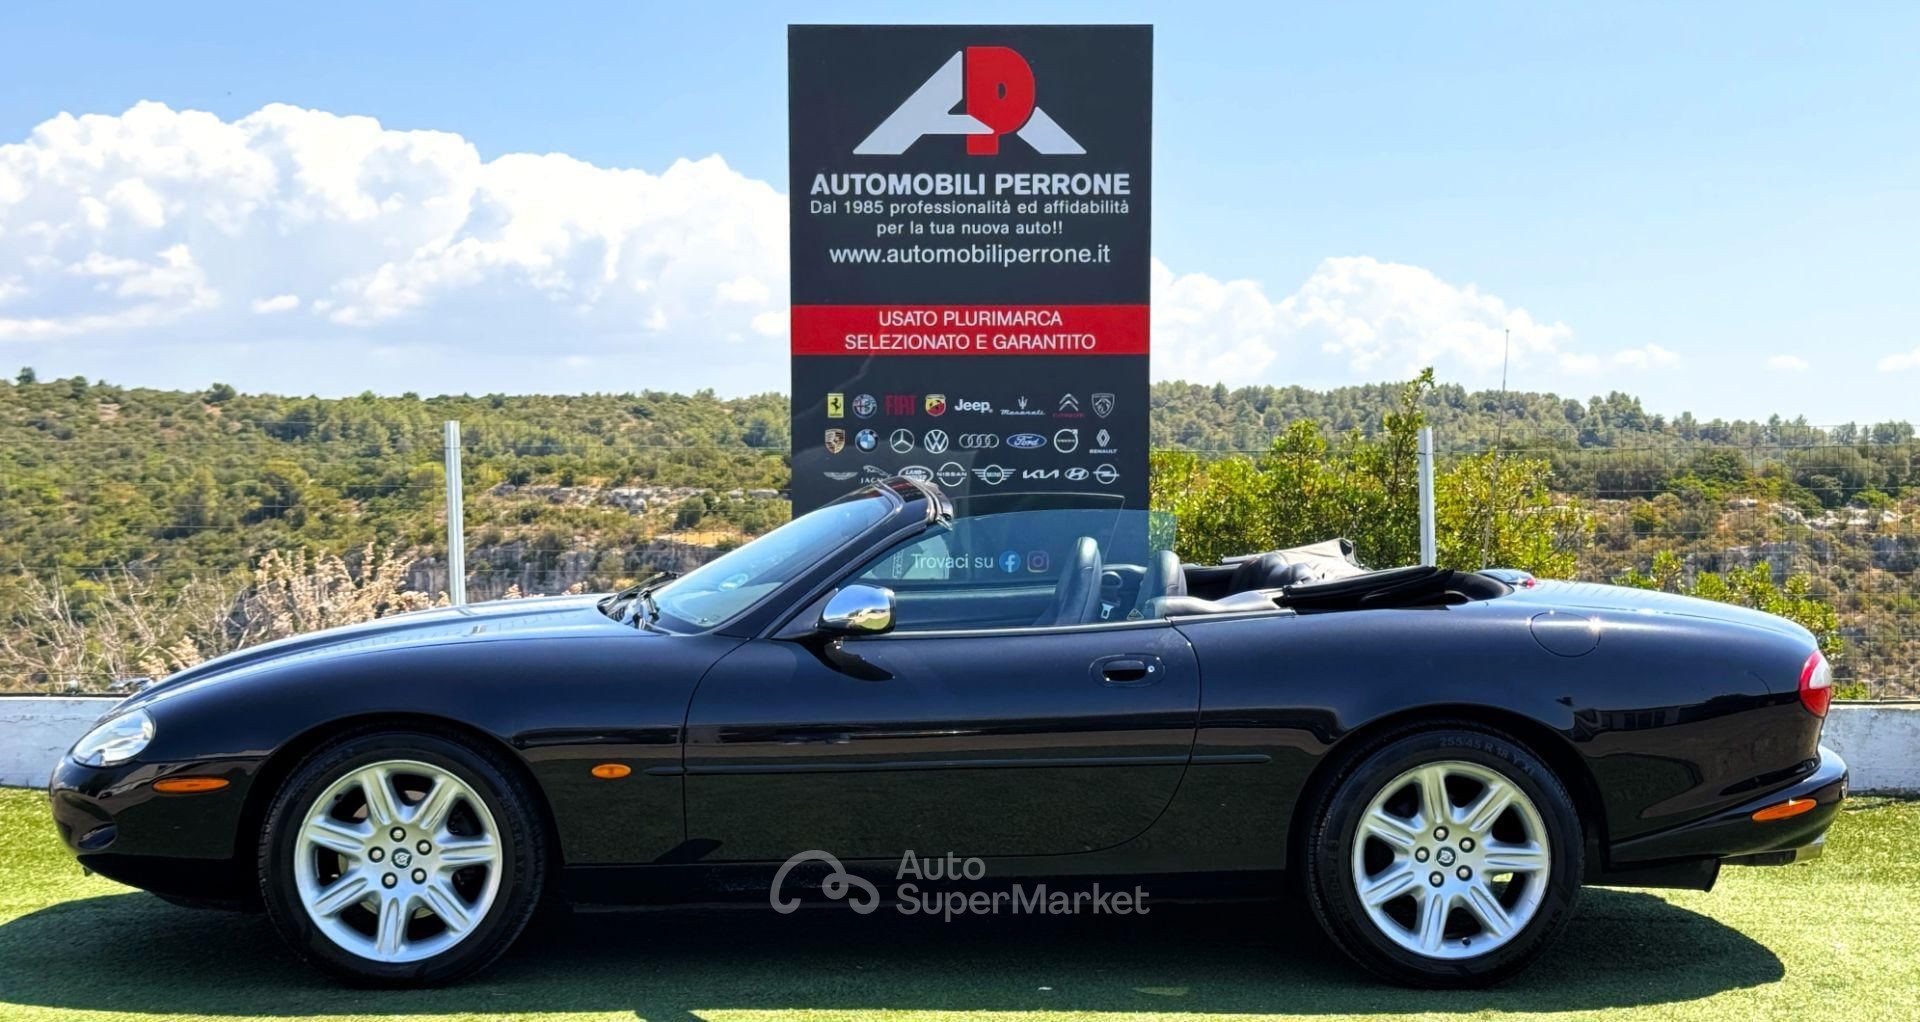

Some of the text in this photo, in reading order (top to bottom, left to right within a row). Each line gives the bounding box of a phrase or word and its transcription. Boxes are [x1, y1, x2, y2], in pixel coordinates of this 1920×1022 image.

[810, 173, 1130, 195] AUTOMOBILI PERRONE
[810, 199, 1129, 217] Dal 1985 professionalità ed affidabilità
[877, 220, 1063, 238] per la tua nuova auto!!
[829, 244, 1111, 267] www.automobiliperrone.it
[878, 310, 1062, 327] USATO PLURIMARCA
[844, 334, 1096, 351] SELEZIONATO E GARANTITO
[885, 395, 917, 416] FIAT
[954, 399, 990, 413] Jeep
[1013, 436, 1040, 447] Ford
[911, 553, 969, 569] Trovaci
[974, 557, 994, 569] su
